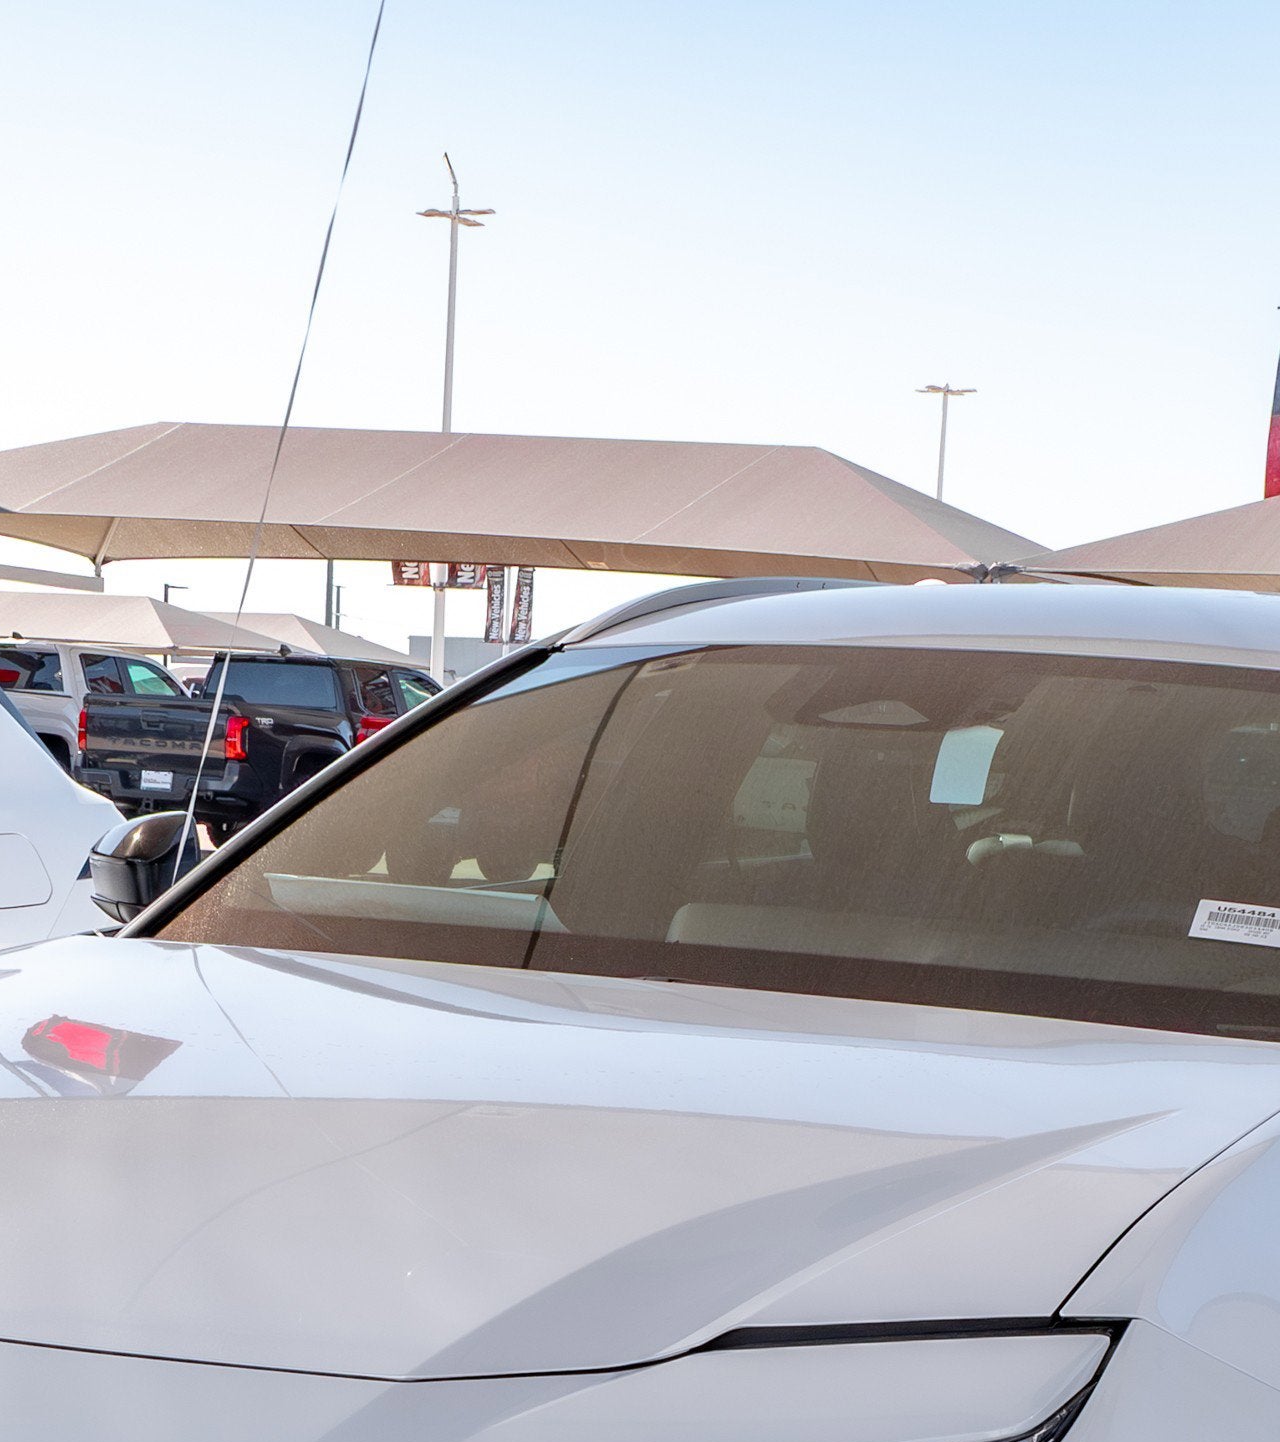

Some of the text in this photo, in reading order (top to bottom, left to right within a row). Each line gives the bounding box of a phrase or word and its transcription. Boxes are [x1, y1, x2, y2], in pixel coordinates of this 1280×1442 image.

[491, 584, 502, 620] Vehicles
[518, 584, 531, 621] Vehicles
[489, 620, 500, 640] New
[516, 620, 527, 641] New
[255, 717, 274, 725] TRD
[111, 737, 203, 750] TACOMA
[1217, 906, 1276, 918] U54484
